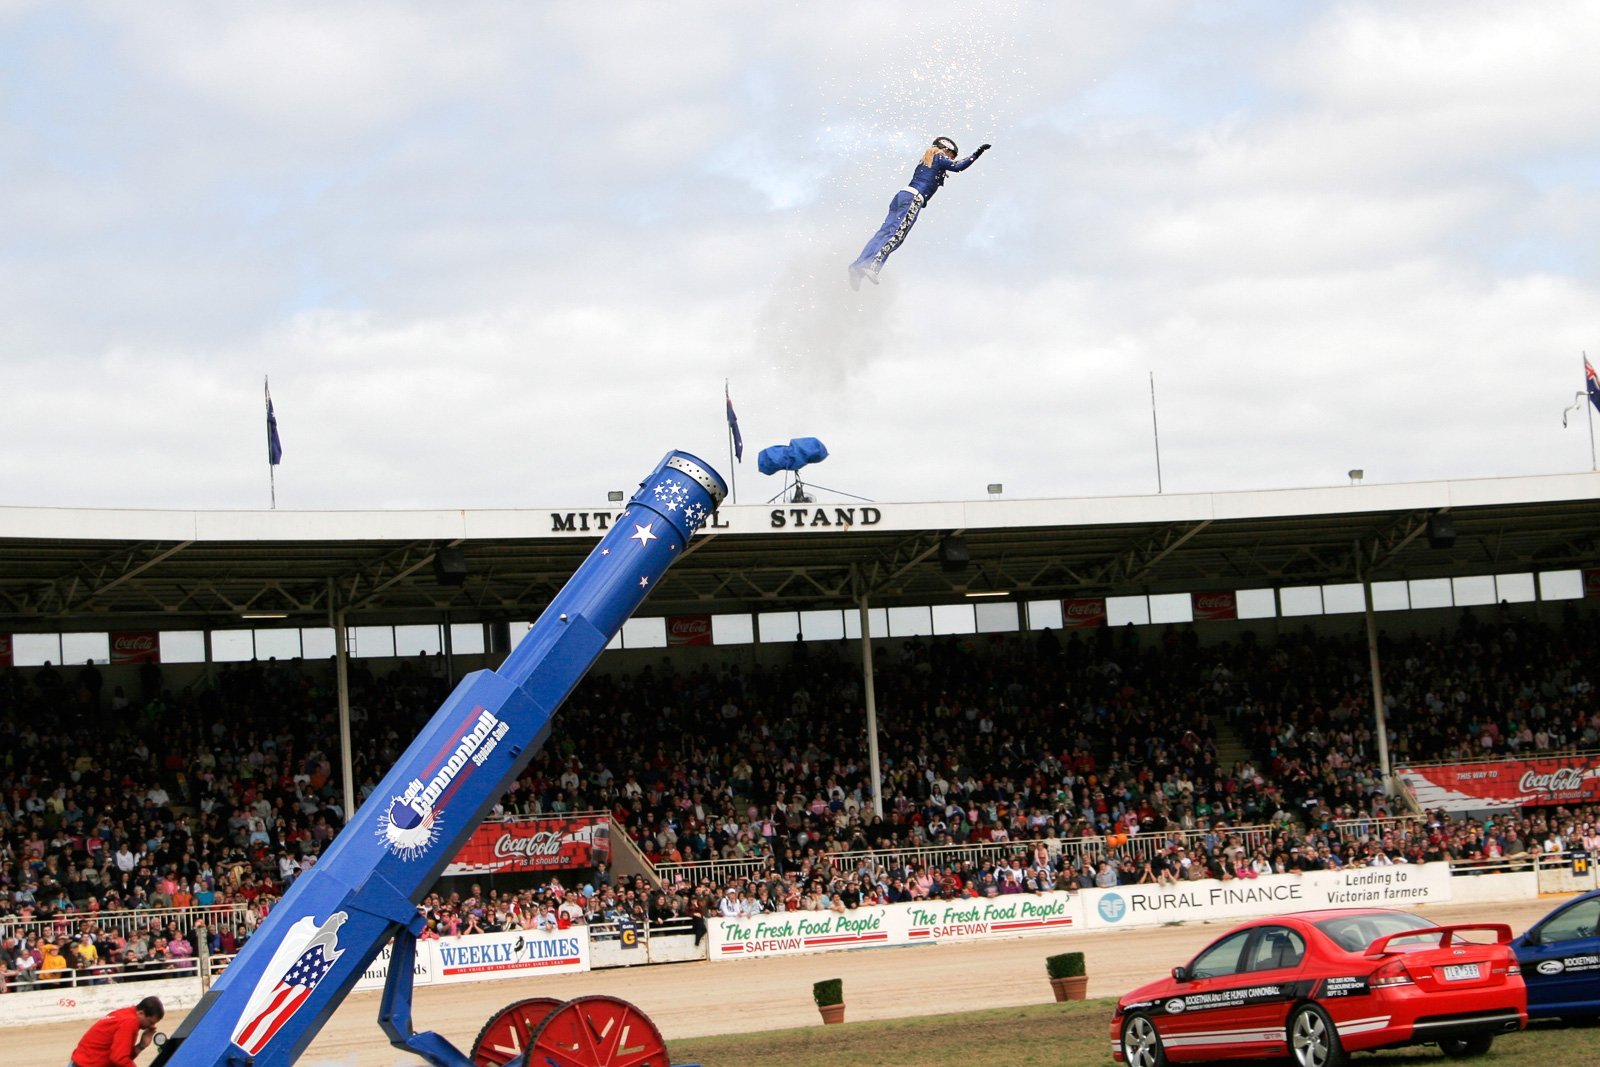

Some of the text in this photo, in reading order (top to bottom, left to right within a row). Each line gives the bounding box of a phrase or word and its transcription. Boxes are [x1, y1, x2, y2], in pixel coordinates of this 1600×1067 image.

[770, 507, 881, 528] STAND
[411, 709, 498, 817] Cannonball
[1457, 770, 1498, 781] THIS WAY TO
[1518, 767, 1584, 793] Coca-Cola
[494, 831, 563, 858] Coca-Cola
[535, 856, 559, 865] should
[1574, 858, 1586, 872] H
[1346, 871, 1407, 886] Lending to
[1132, 884, 1303, 911] RURAL FINANCE
[1327, 887, 1429, 903] Victorian farmers
[943, 906, 980, 924] Fresh
[984, 903, 1016, 920] Food
[623, 930, 635, 945] G
[755, 920, 794, 939] Fresh
[797, 917, 831, 935] Food
[933, 923, 988, 938] SAFEWAY
[440, 943, 512, 966] WEEKLY
[526, 937, 580, 959] TIMES
[745, 938, 802, 953] SAFEWAY
[1185, 993, 1211, 1005] ROCKETMAN
[1231, 989, 1248, 999] HUMAN
[1248, 986, 1280, 997] CANNONBALL
